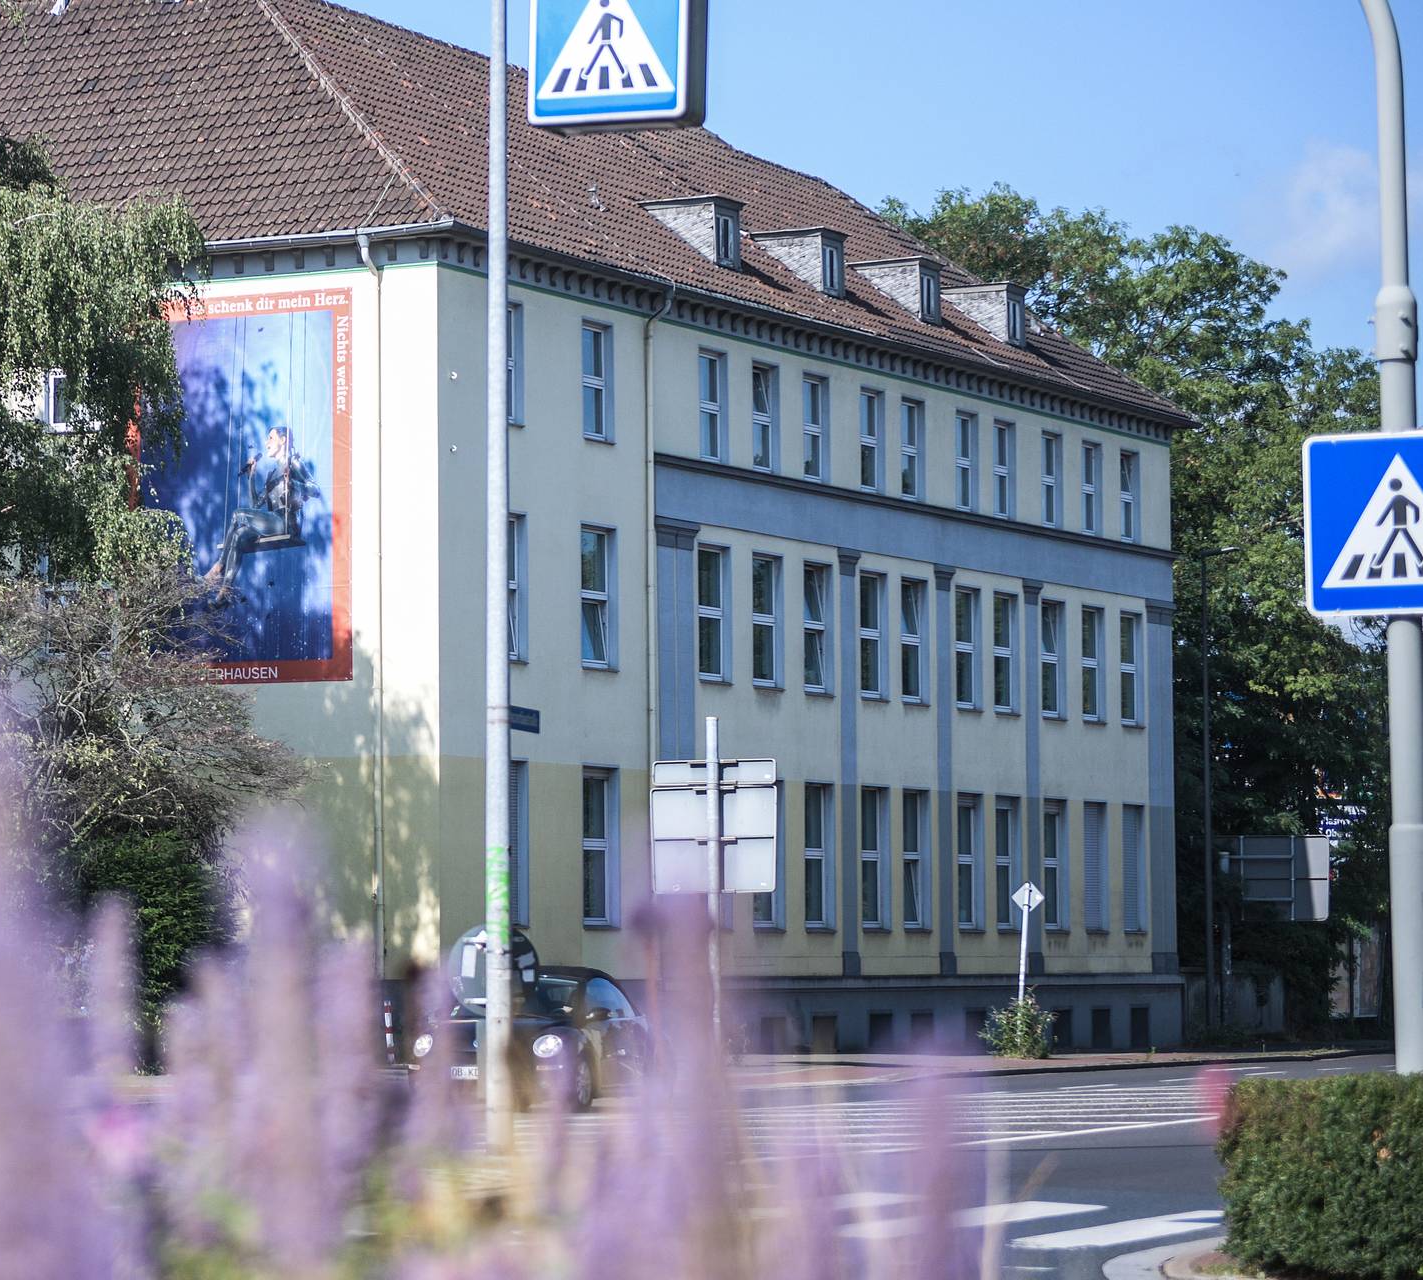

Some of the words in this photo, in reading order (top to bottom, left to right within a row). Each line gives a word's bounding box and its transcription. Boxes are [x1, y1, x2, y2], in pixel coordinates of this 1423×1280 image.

[208, 299, 253, 315] schenk
[256, 296, 274, 311] dir
[278, 296, 311, 308] mein
[314, 292, 349, 306] Herz.
[336, 315, 347, 363] Nichts
[336, 365, 347, 414] weiter.
